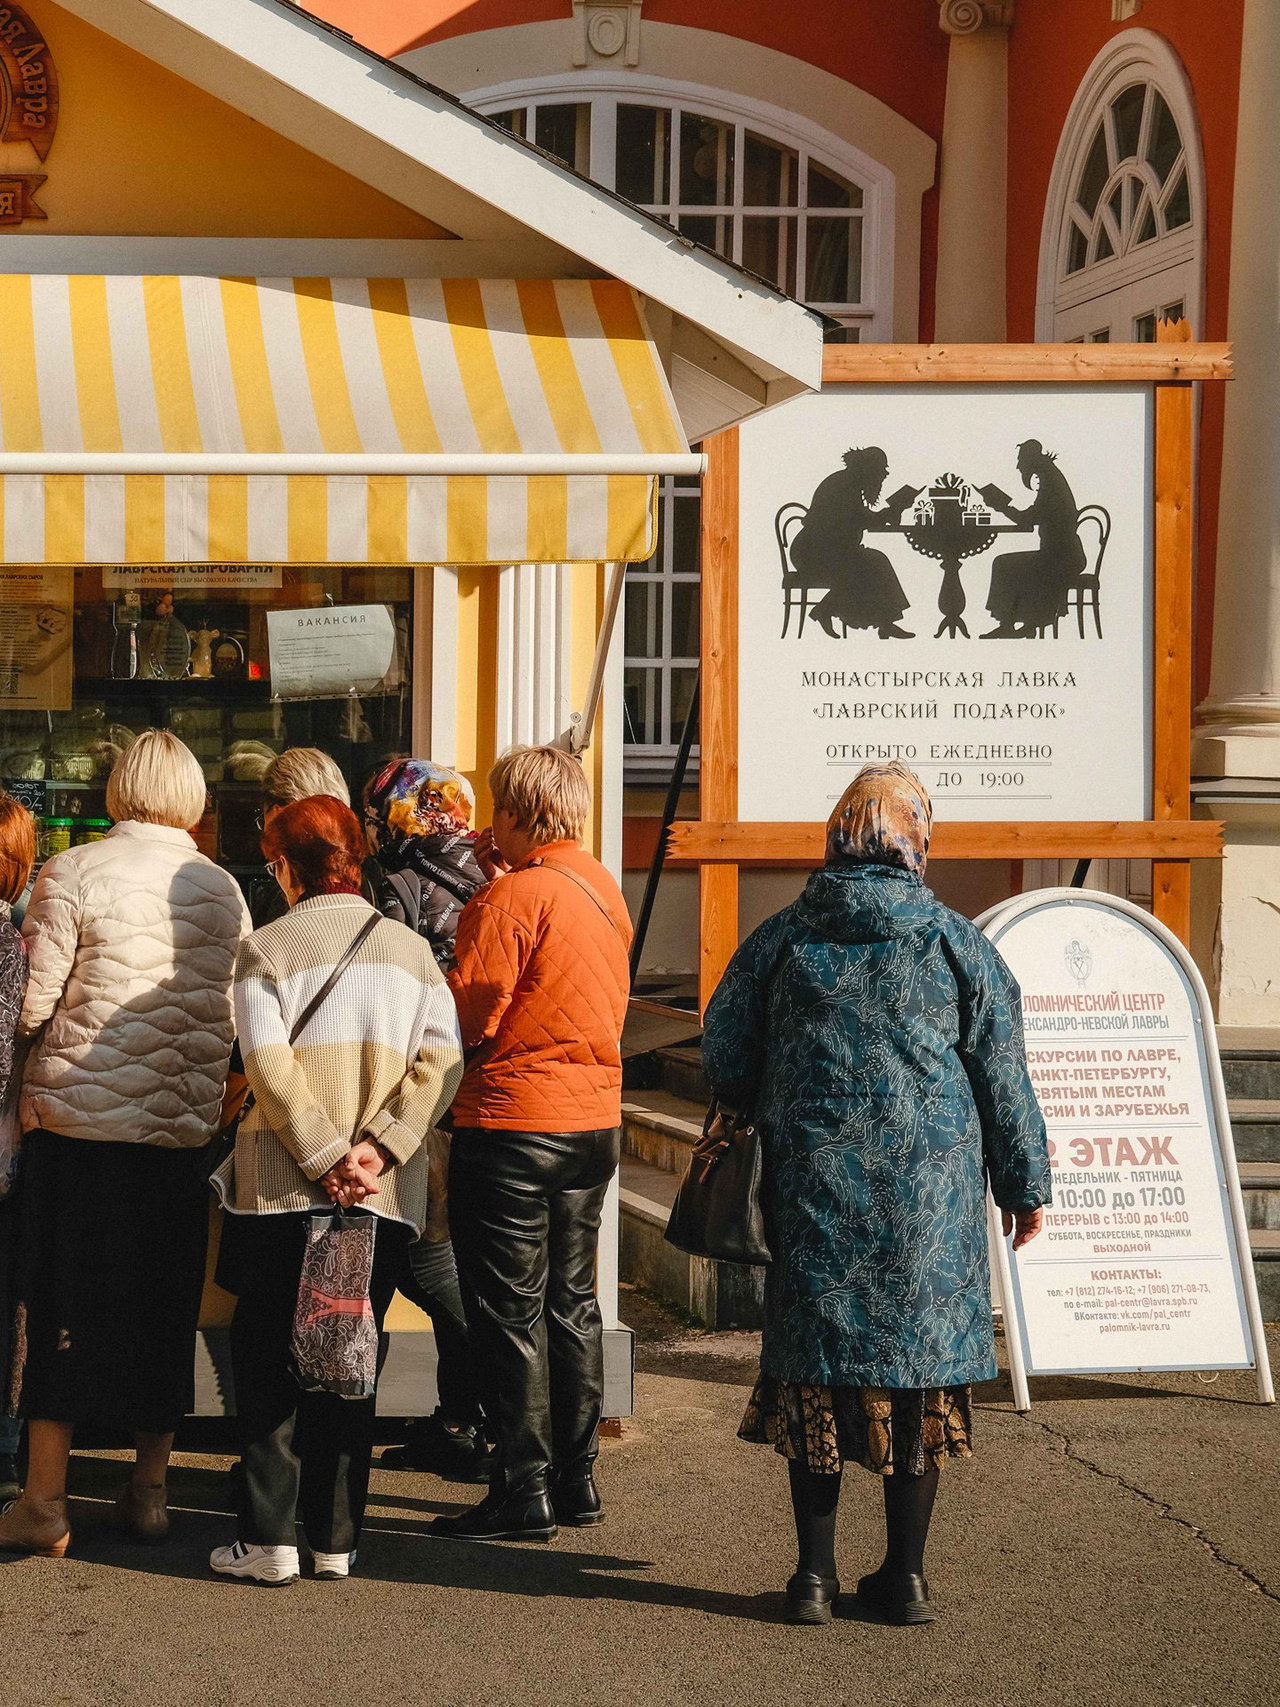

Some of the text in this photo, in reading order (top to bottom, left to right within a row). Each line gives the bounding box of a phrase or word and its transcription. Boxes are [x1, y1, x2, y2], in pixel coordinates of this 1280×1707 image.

[12, 43, 48, 128] Лавра
[113, 565, 273, 573] ЛАВРСКАЯ СЫРОВАРНЯ
[134, 576, 179, 584] НАТУРАЛЬНЫЙ
[298, 615, 366, 627] ВАКАНСИЯ
[801, 671, 1078, 688] МОНАСТЫРСКАЯ ЛАВКА
[812, 699, 1066, 721] «ЛАВРСКИЙ ПОДАРОК»
[826, 744, 1053, 760] ОТКРЫТО ЕЖЕДНЕВНО
[936, 772, 962, 788] ДО
[979, 772, 1025, 788] 19:00
[421, 858, 460, 886] TOKYO LONDON
[1023, 991, 1166, 1013] ЛОМНИЧЕСКИЙ ЦЕНТР
[1023, 1014, 1170, 1032] ЕКСАНДРО-НЕВСКОЙ ЛАВРЫ
[1026, 1049, 1181, 1064] СКУРСИИ ПО ЛАВРЕ,
[1031, 1067, 1171, 1082] АНКТ-ПЕТЕРБУРГУ,
[1034, 1085, 1166, 1099] СВЯТЫМ МЕСТАМ
[1080, 1104, 1091, 1117] И
[1095, 1103, 1190, 1117] ЗАРУБЕЖЬЯ
[1069, 1137, 1180, 1168] ЭТАЖ
[1052, 1172, 1122, 1186] НЕДЕЛЬНИК
[1131, 1170, 1183, 1183] ПЯТНИЦА
[1058, 1186, 1186, 1211] 10:00 до 17:00
[1045, 1211, 1189, 1227] ПЕРЕРЫВ с 13:00 до 14:00
[1048, 1229, 1192, 1242] СУББОТА, ВОСКРЕСЕНЬЕ, ПРАЗДНИКИ
[1093, 1242, 1152, 1254] ВЫХОДНОЙ
[1091, 1269, 1162, 1281] КОНТАКТЫ:
[1047, 1283, 1211, 1297] тел: +7 (812) 274-16-12; +7 (906) 271-08-73,
[1064, 1297, 1198, 1310] по e-mail: pal-centr@lavra.spb.ru
[1074, 1309, 1192, 1321] ВКонтакте: vk.com/pal_centr
[1099, 1322, 1171, 1334] palomnik-lavra.ru
